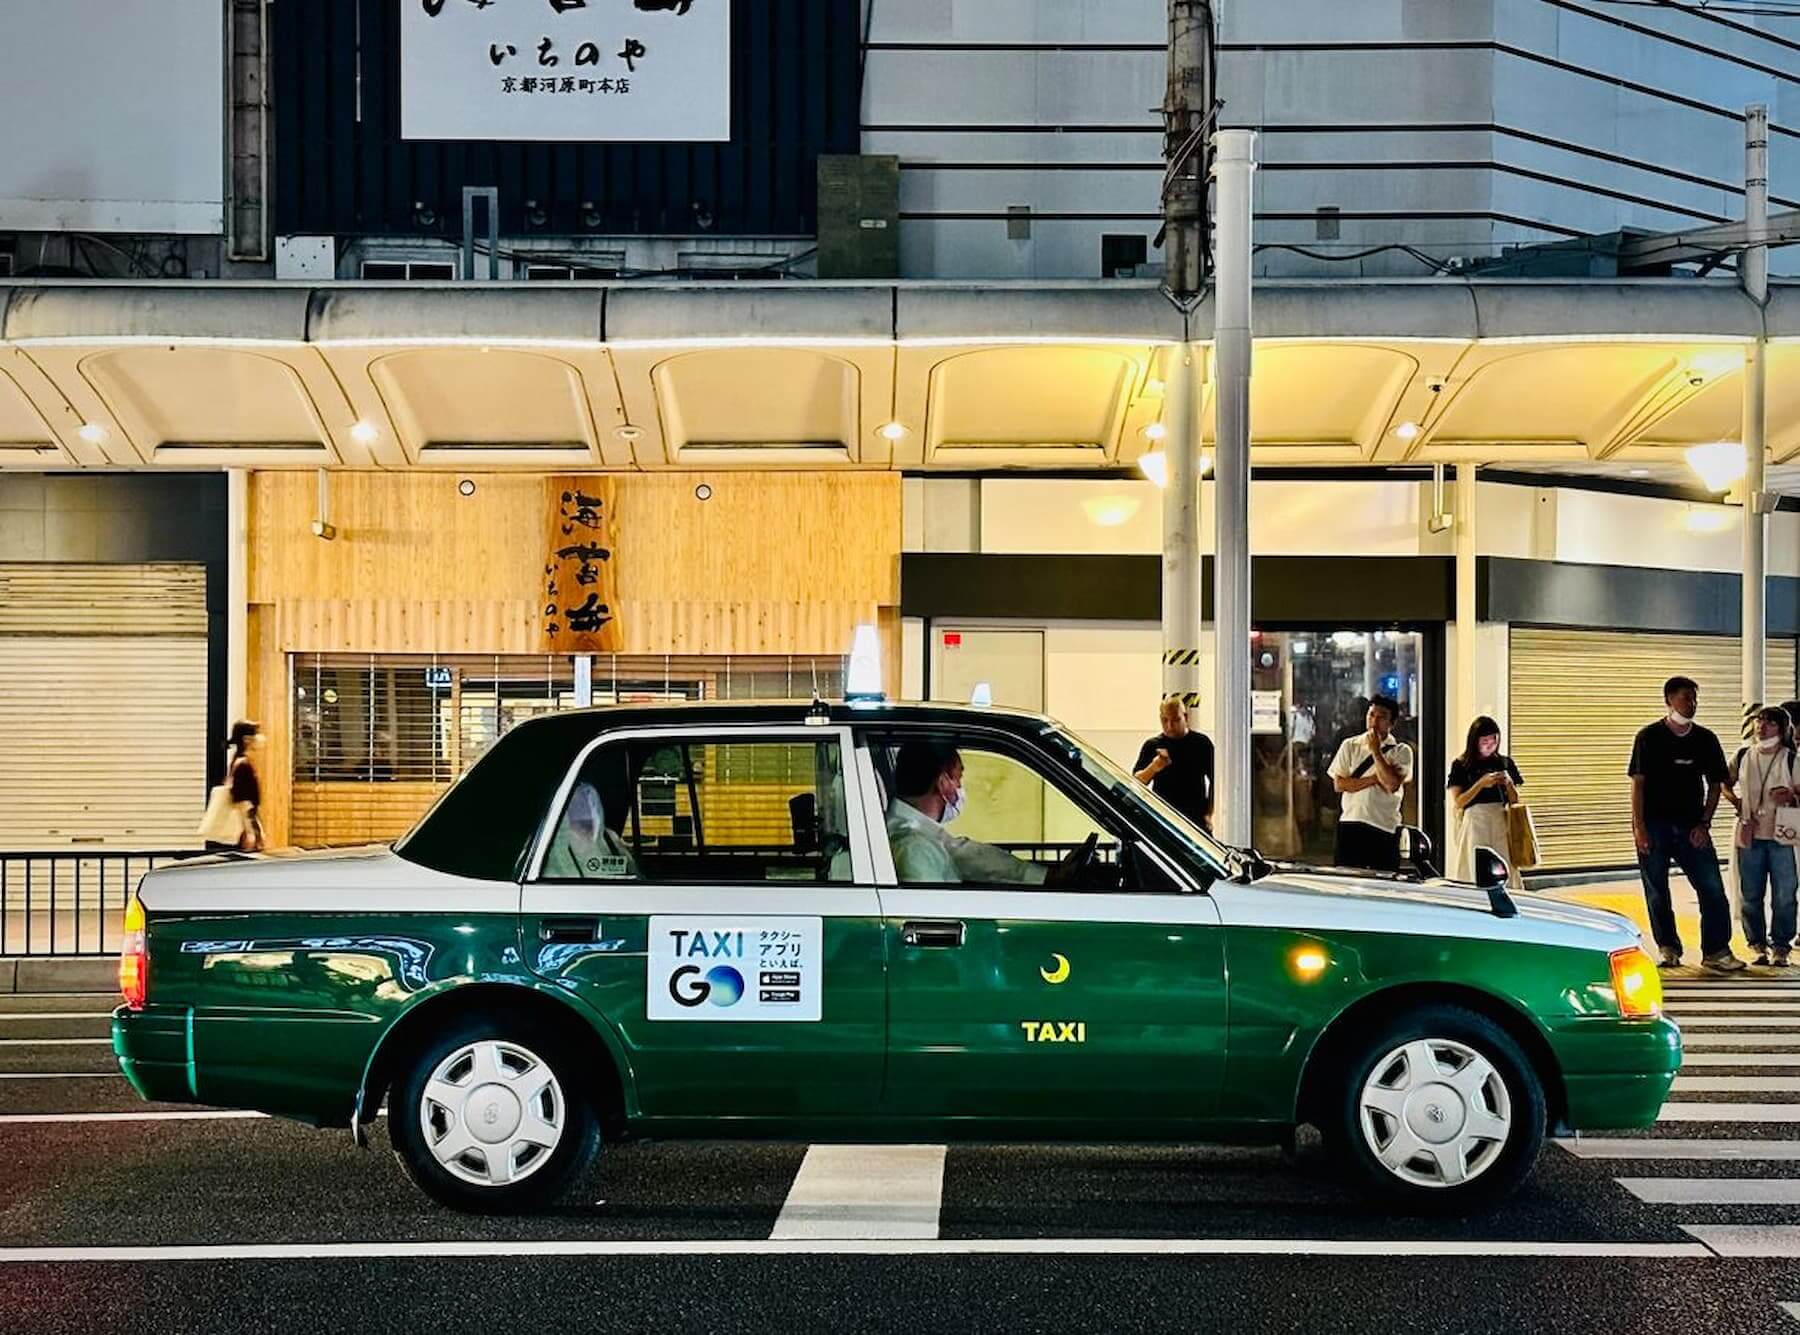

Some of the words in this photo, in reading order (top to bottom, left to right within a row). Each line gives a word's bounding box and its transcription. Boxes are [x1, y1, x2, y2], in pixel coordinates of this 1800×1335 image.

[489, 36, 647, 72] いちのや
[501, 76, 631, 94] 京都河原町本店
[545, 563, 560, 639] いちのや
[669, 930, 744, 958] TAXI
[759, 930, 802, 942] タクシー
[759, 943, 801, 957] アプリ
[669, 964, 745, 1008] GO
[1021, 1022, 1086, 1043] TAXI
